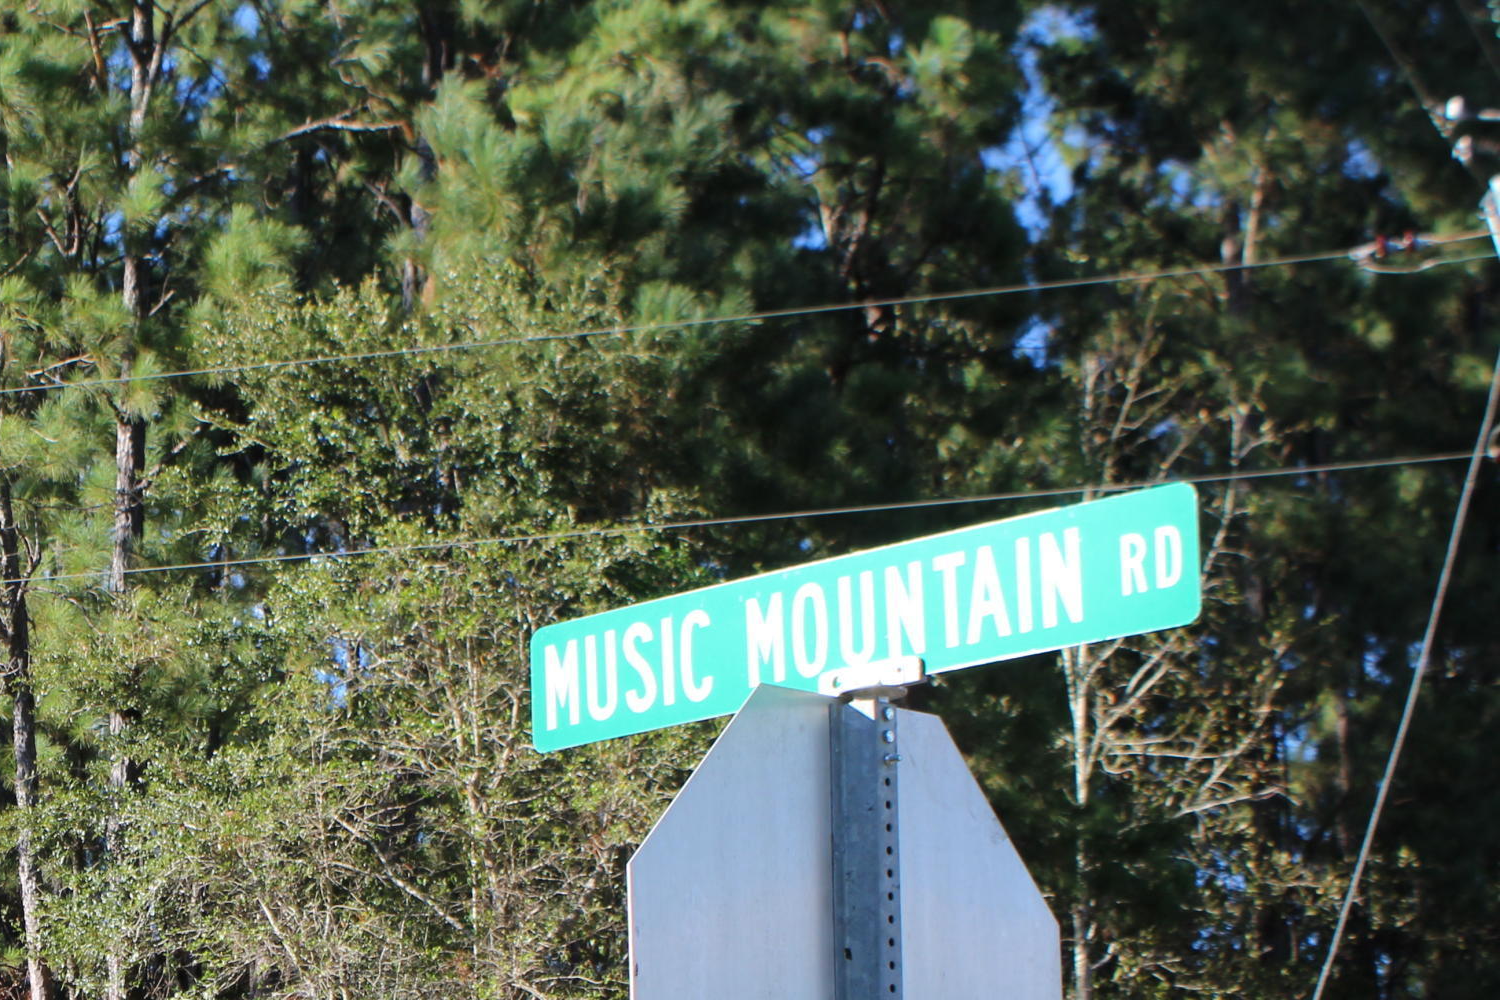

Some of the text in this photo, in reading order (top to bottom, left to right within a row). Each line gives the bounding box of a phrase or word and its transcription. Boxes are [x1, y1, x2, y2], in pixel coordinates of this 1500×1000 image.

[544, 525, 1183, 731] MUSIC MOUNTAIN RD
